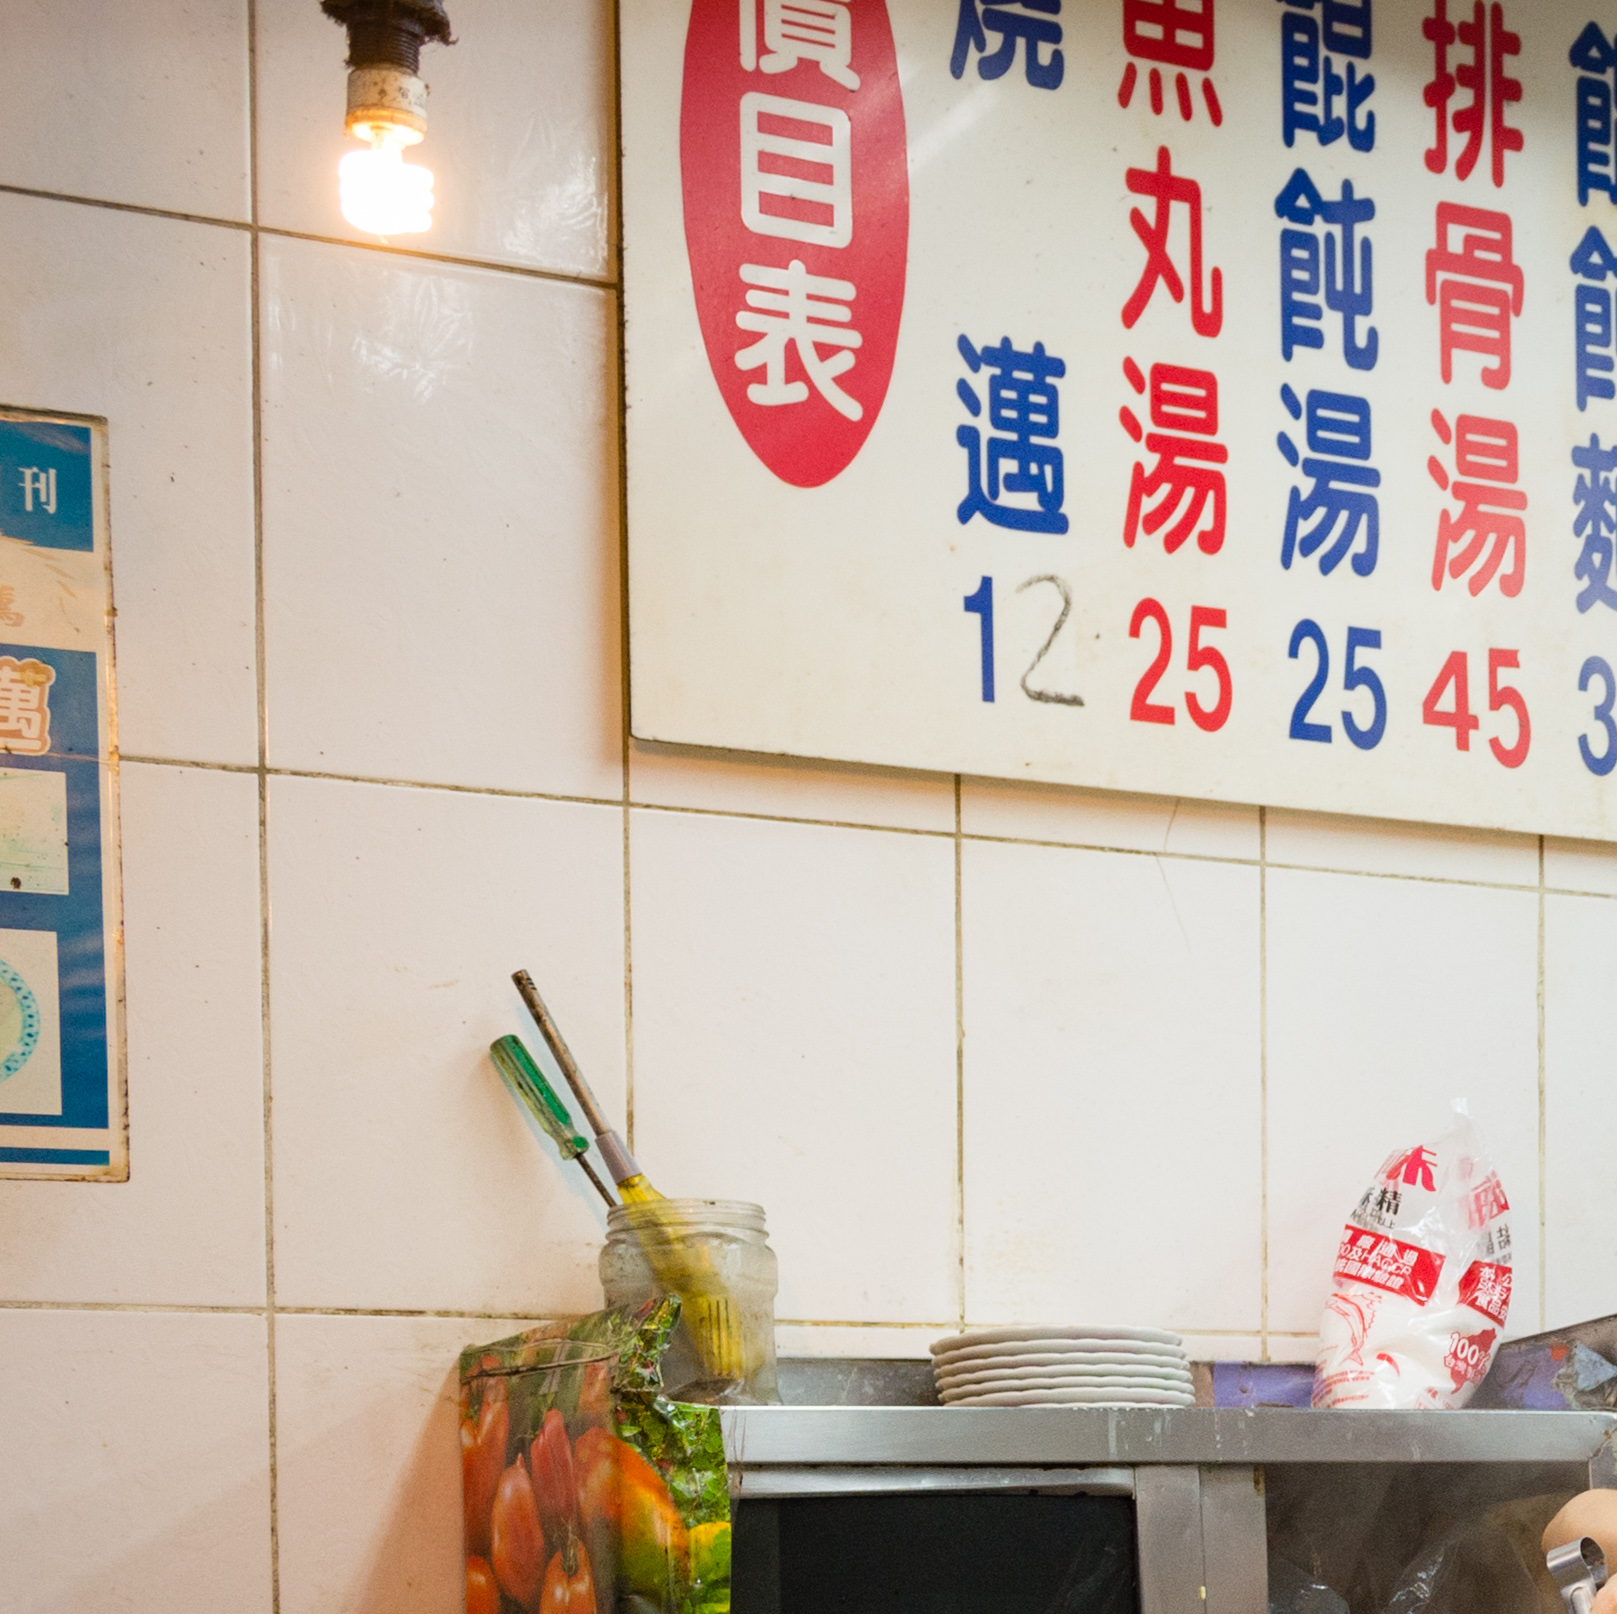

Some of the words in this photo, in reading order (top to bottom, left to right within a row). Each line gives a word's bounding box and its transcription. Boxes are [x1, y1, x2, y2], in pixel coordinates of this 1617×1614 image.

[1115, 0, 1230, 557] 魚丸湯
[1271, 0, 1381, 577] 餛飩湯
[1420, 0, 1528, 599] 排骨湯
[18, 466, 58, 515] 刊
[963, 573, 1084, 708] 12
[1126, 594, 1234, 734] 25
[1287, 617, 1386, 749] 25
[1420, 645, 1532, 769] 45
